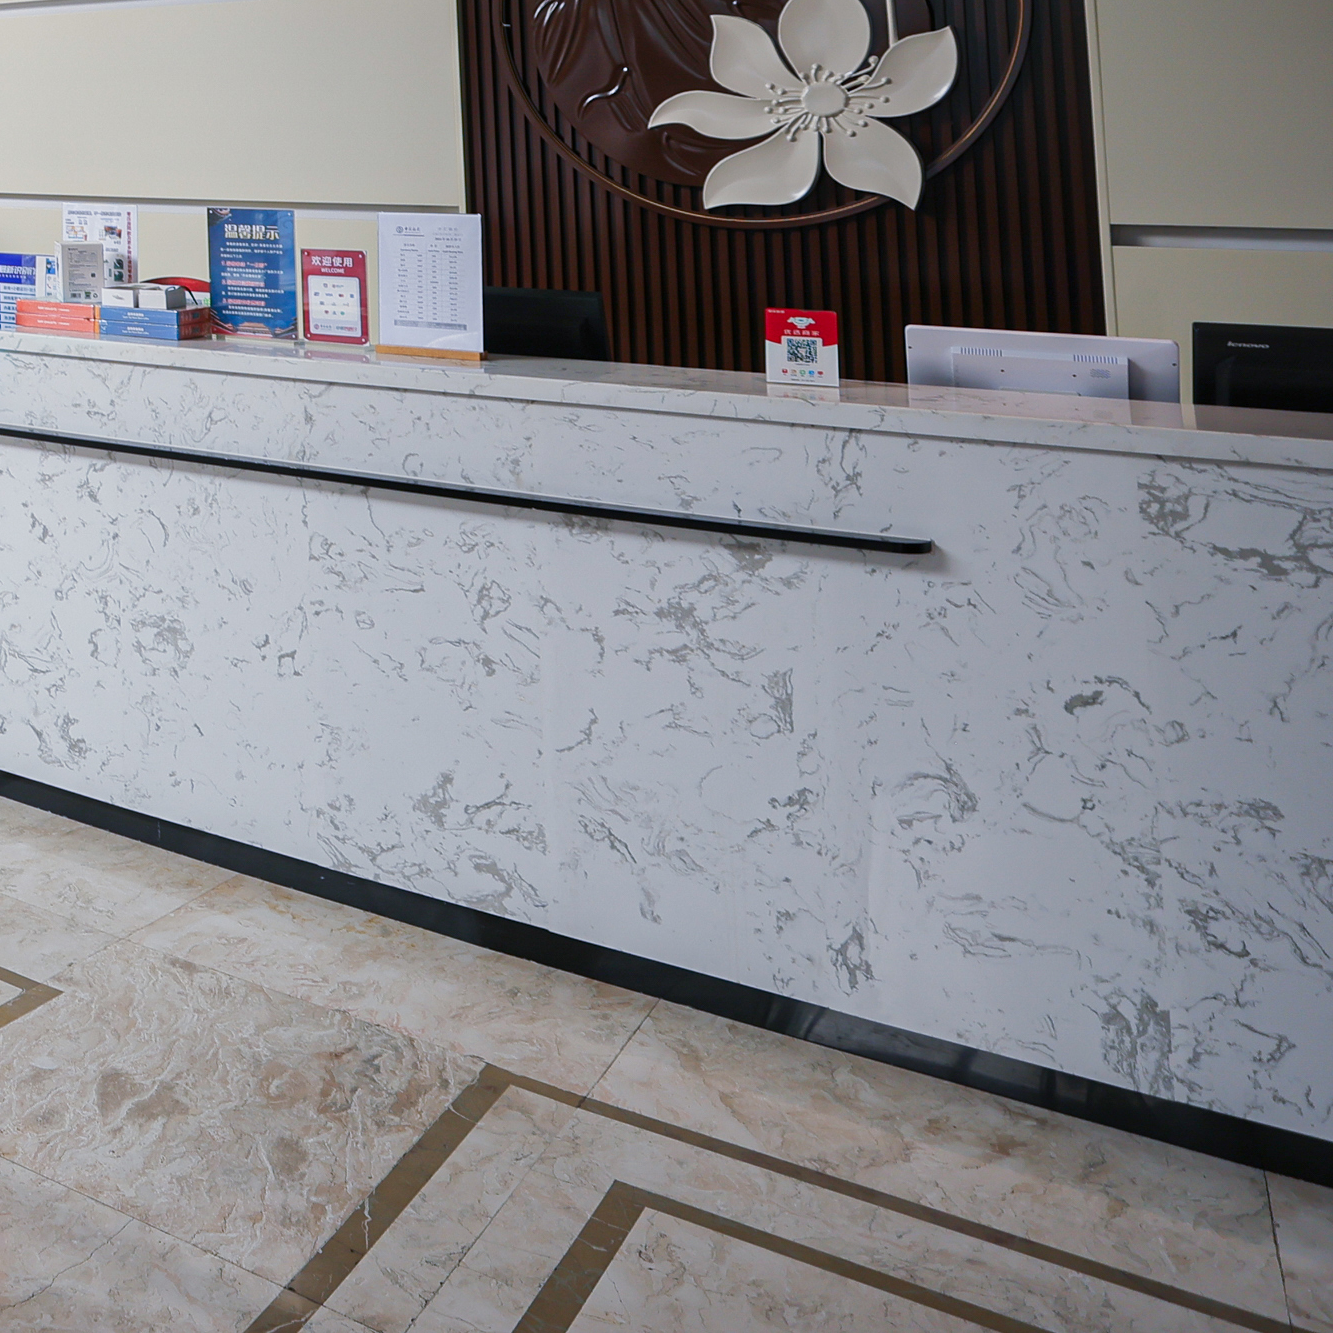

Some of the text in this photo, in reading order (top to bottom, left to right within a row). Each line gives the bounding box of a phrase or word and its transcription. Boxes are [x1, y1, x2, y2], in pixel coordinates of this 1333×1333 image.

[224, 223, 280, 240] 温馨提示
[311, 256, 354, 268] 欢迎使用
[1226, 341, 1270, 350] lenovo
